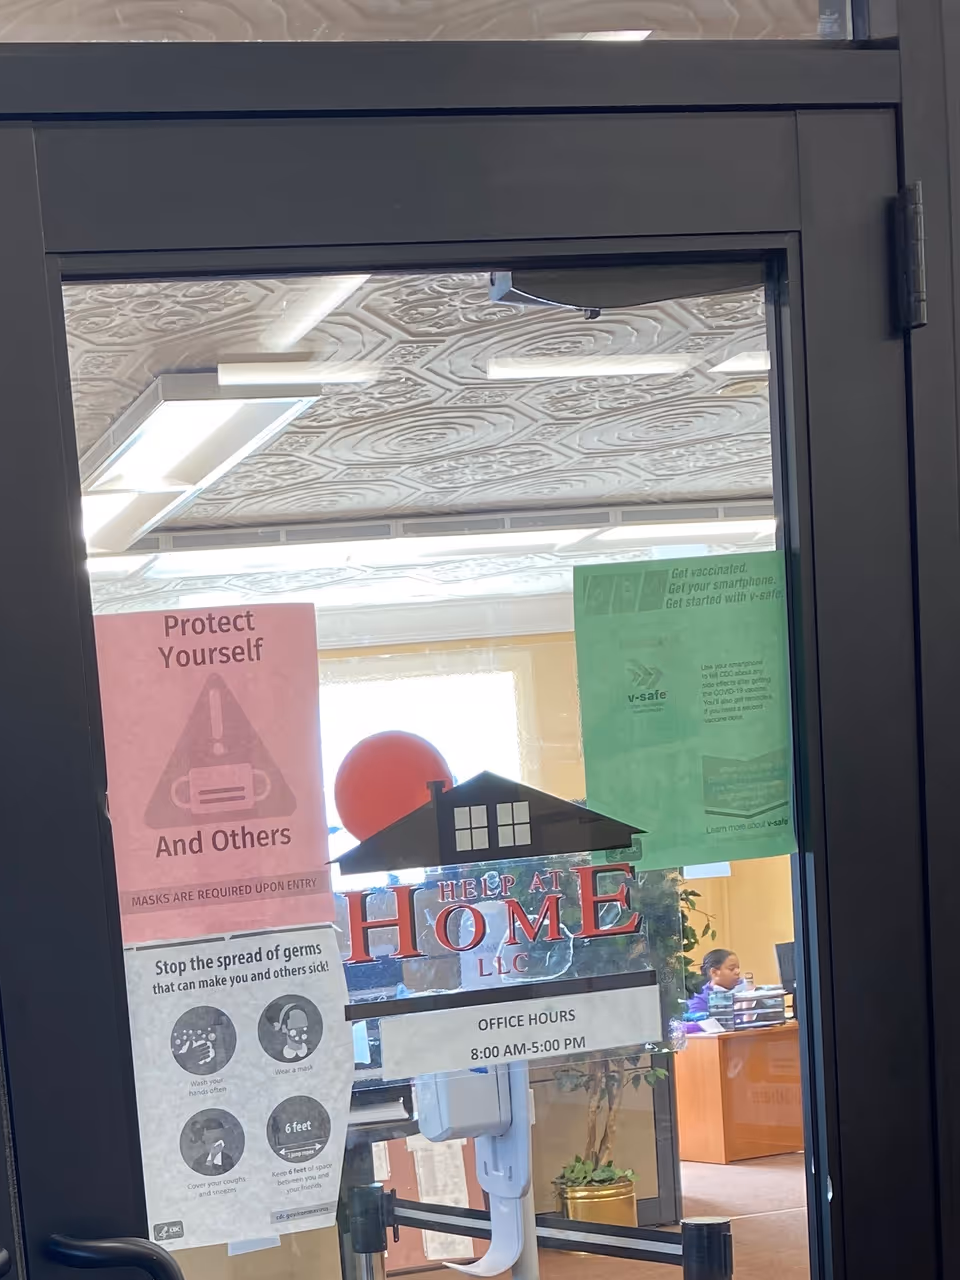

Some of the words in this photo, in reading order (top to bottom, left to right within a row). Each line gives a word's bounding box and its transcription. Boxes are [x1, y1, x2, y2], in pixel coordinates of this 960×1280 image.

[671, 568, 688, 579] Get
[691, 562, 748, 578] vaccinated.
[668, 583, 685, 595] Get
[687, 581, 711, 595] your
[713, 574, 776, 593] smartphone.
[665, 598, 684, 609] Get
[685, 593, 722, 608] started
[725, 591, 746, 604] with
[164, 610, 255, 638] Protect
[158, 637, 264, 669] Yourself
[156, 831, 202, 858] And
[212, 826, 291, 853] Others
[131, 893, 170, 907] MASKS
[172, 891, 194, 903] ARE
[197, 885, 252, 901] REQUIRED
[255, 881, 284, 895] UPON
[287, 878, 317, 890] ENTRY
[439, 874, 515, 902] HELP
[529, 869, 564, 892] AT
[342, 862, 644, 964] HOME
[155, 959, 187, 977] Stop
[190, 955, 214, 971] the
[217, 946, 263, 970] spread
[266, 944, 281, 962] of
[283, 943, 322, 963] germs
[478, 953, 530, 977] LLC
[152, 981, 175, 995] that
[177, 980, 196, 991] can
[198, 974, 228, 989] make
[229, 973, 249, 988] you
[250, 968, 271, 982] and
[273, 964, 306, 980] others
[308, 960, 330, 976] sick!
[477, 1014, 525, 1032] OFFICE
[528, 1009, 576, 1026] HOURS
[470, 1046, 500, 1061] 8:00
[503, 1039, 561, 1058] AM-5:00
[564, 1036, 586, 1051] PM
[190, 1079, 208, 1087] Wash
[209, 1077, 224, 1086] your
[275, 1068, 292, 1076] Wear
[189, 1089, 209, 1097] hands
[210, 1086, 227, 1094] often
[285, 1123, 292, 1134] 6
[292, 1120, 312, 1133] feet
[293, 1166, 307, 1174] feet
[187, 1181, 206, 1190] Cover
[223, 1175, 246, 1186] coughs
